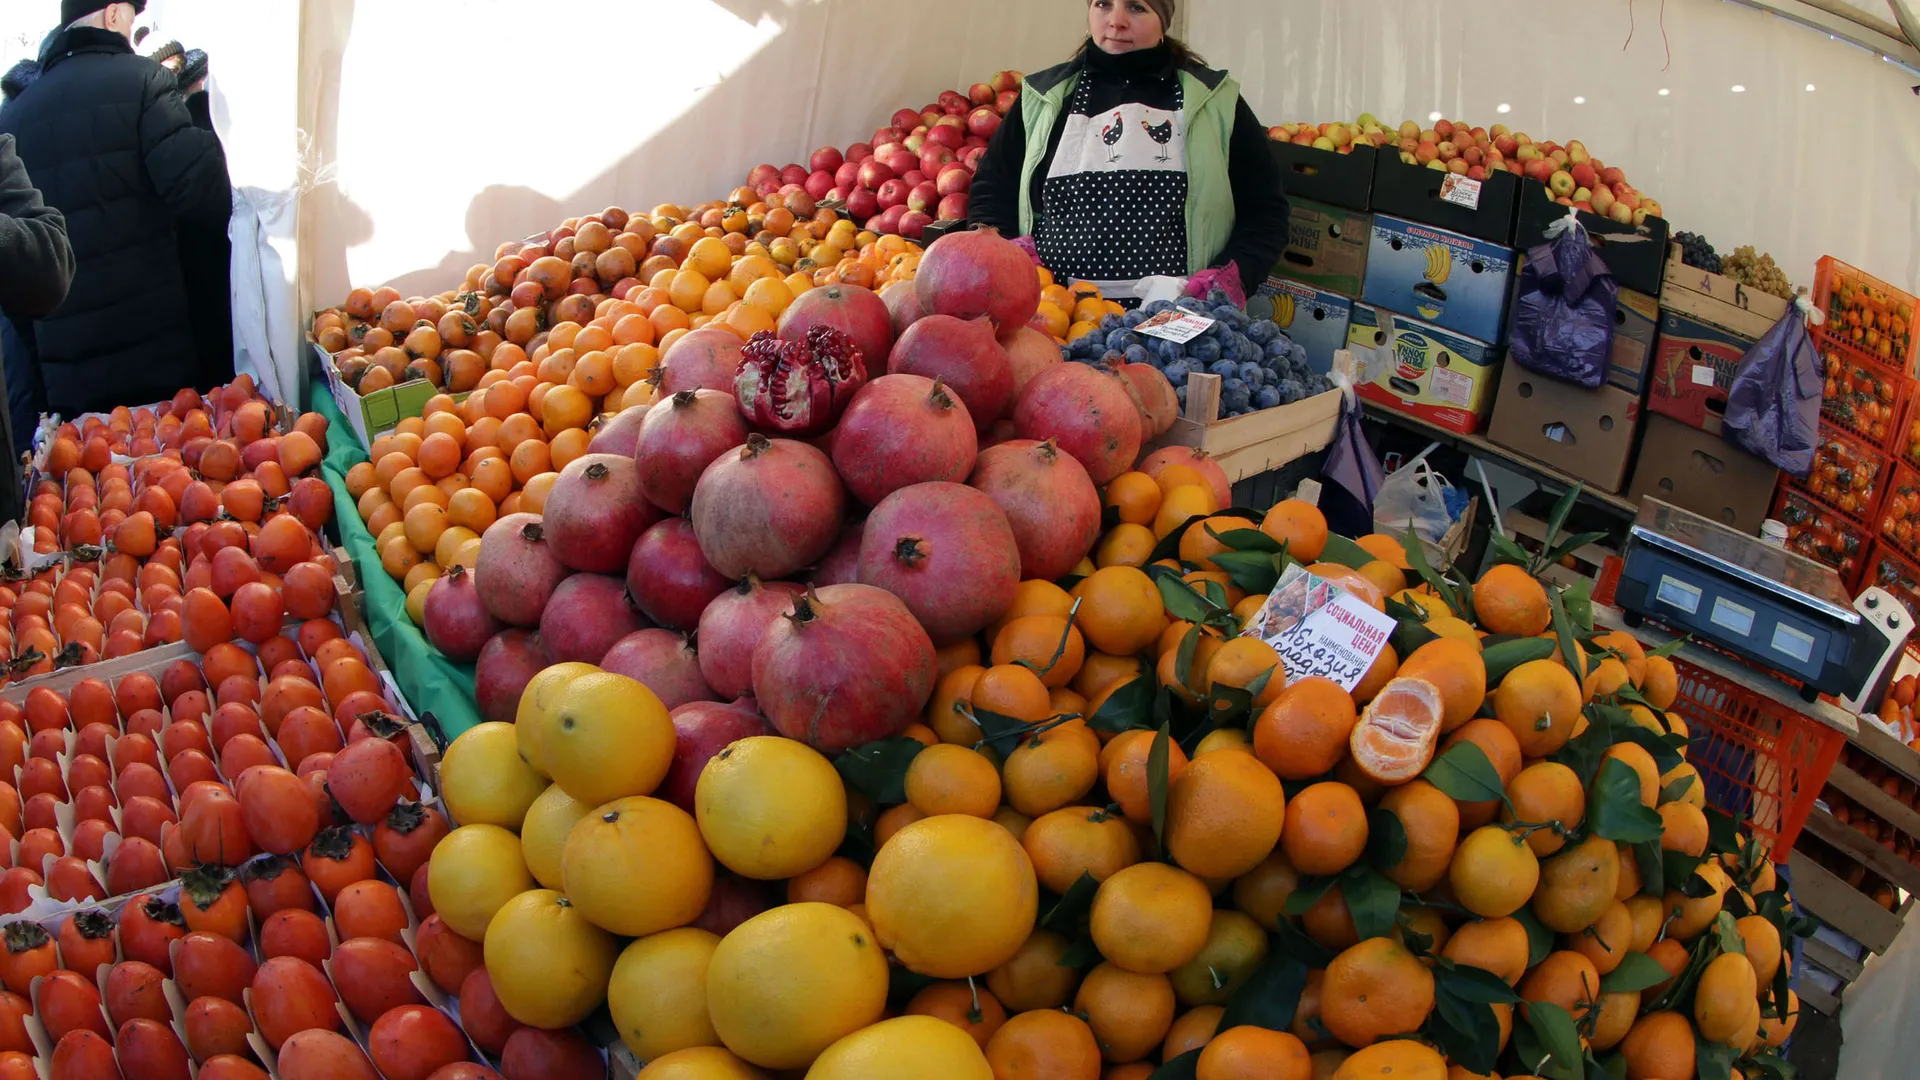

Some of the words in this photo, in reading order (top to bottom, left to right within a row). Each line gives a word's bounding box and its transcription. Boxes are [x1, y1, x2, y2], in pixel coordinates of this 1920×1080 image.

[1406, 226, 1440, 241] BANANAS
[1440, 235, 1474, 250] PREMIUM
[1265, 279, 1286, 290] BANA
[1285, 284, 1316, 299] PREMIUM
[1401, 354, 1424, 369] PRIM
[1325, 601, 1386, 645] СОЦИАЛЬНАЯ
[1282, 615, 1362, 682] Абхазия
[1318, 634, 1368, 669] НАИМЕНОВАНИЕ
[1351, 635, 1377, 657] ЦЕНА
